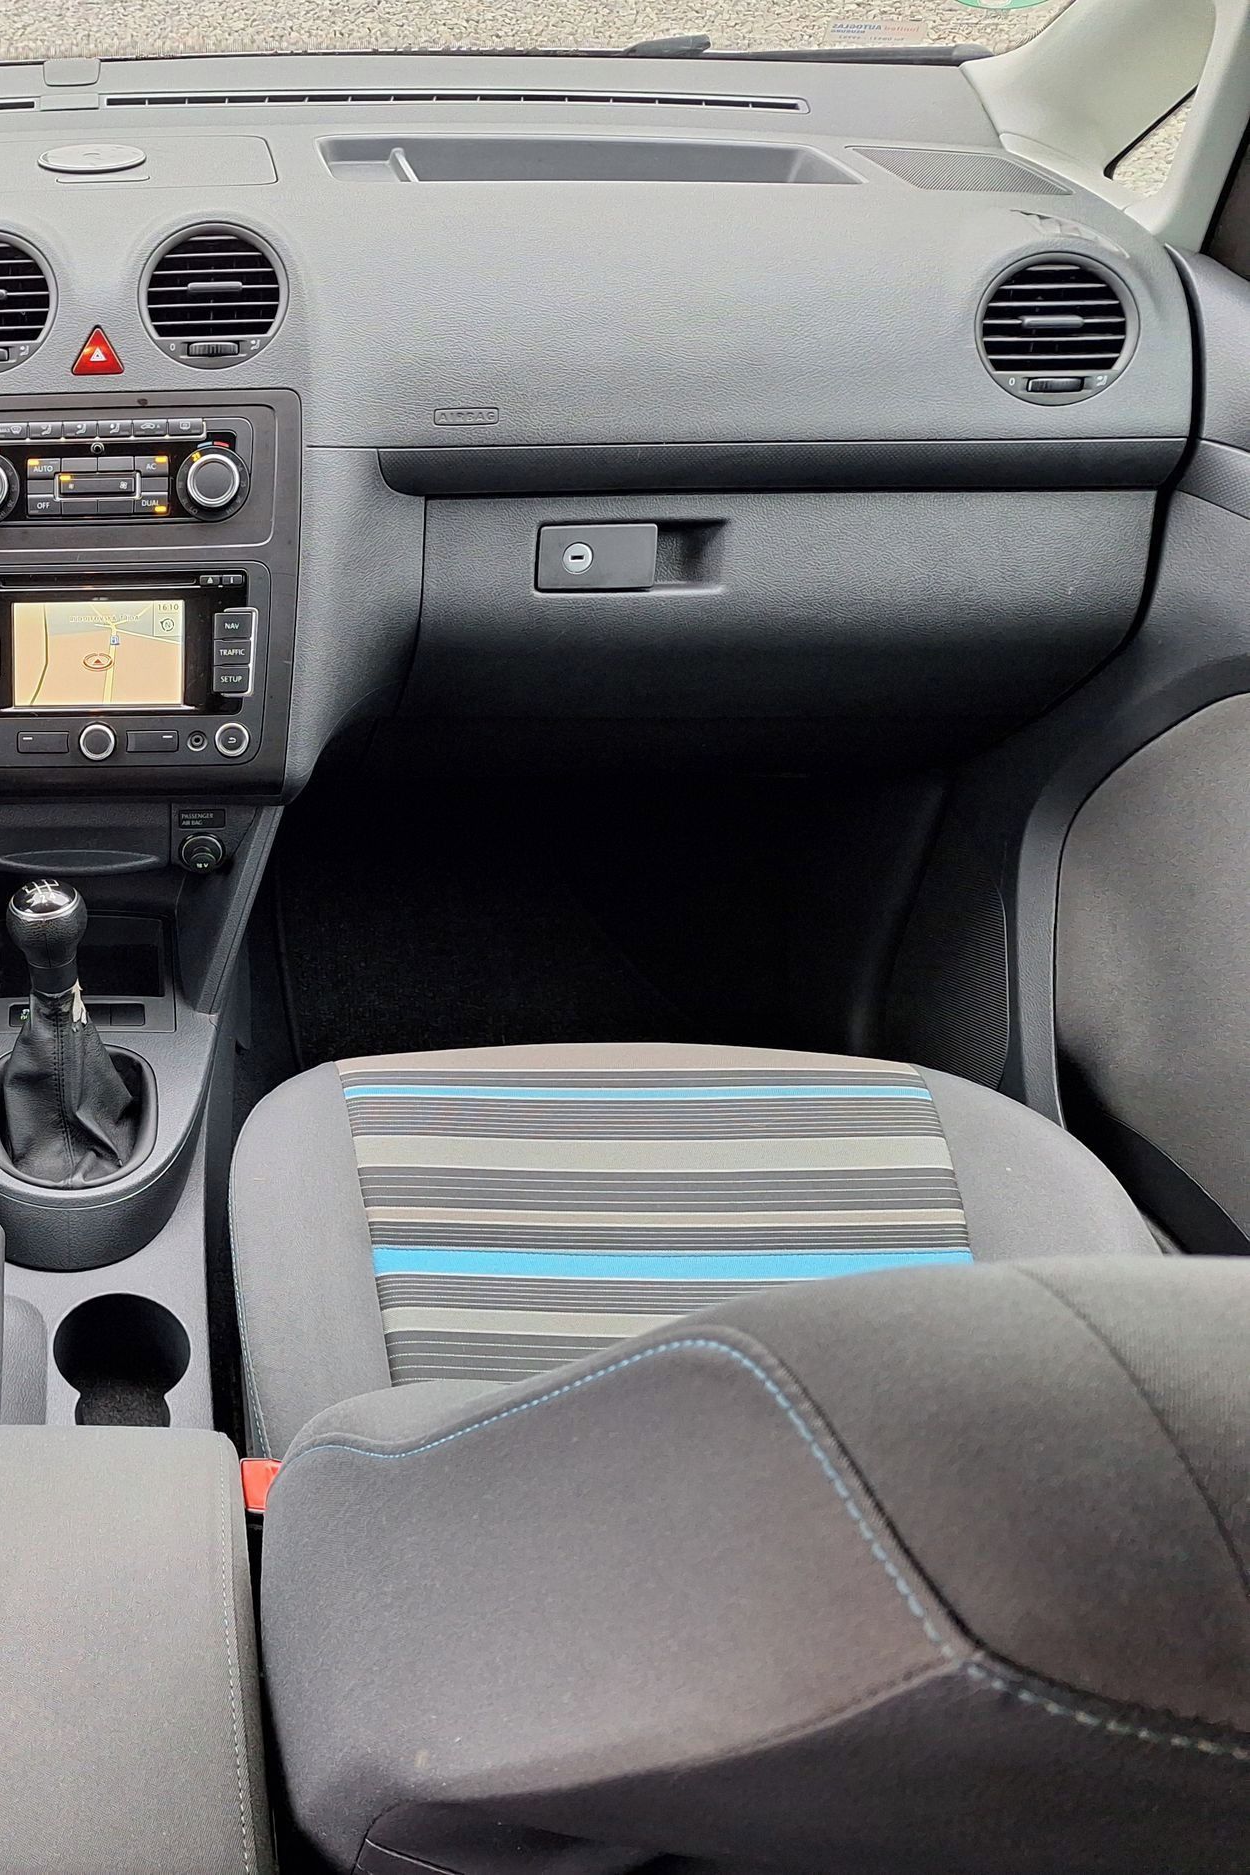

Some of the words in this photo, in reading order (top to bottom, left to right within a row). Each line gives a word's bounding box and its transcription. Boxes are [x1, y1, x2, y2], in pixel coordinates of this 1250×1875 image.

[437, 411, 496, 423] AIRBAG
[33, 465, 54, 473] AUTO
[146, 463, 157, 471] AC
[36, 502, 50, 510] OFF
[141, 499, 160, 507] DUAL
[158, 603, 179, 611] 16:10
[224, 622, 240, 630] NAV
[219, 648, 246, 656] TRAFFIC
[220, 675, 243, 683] SETUP
[181, 812, 214, 820] PASSENGER
